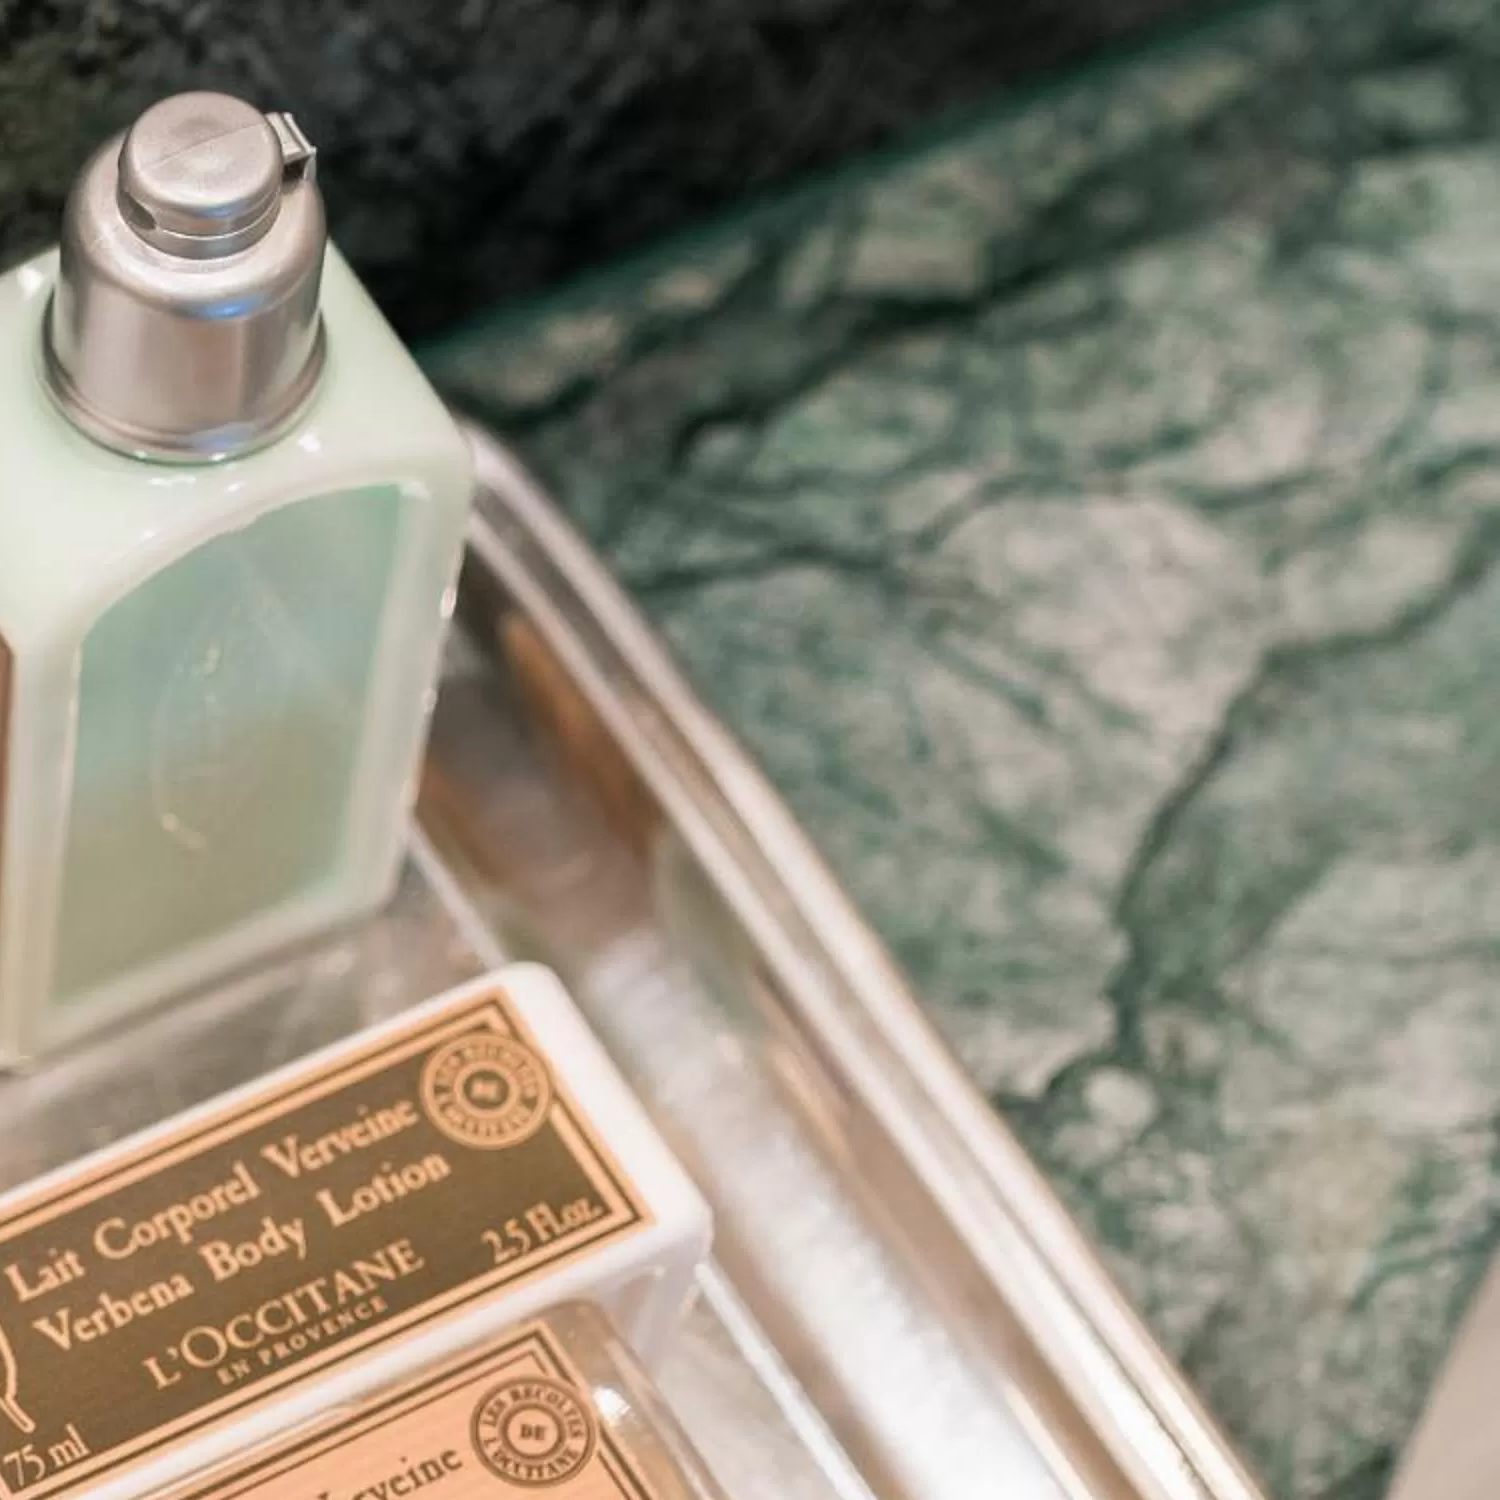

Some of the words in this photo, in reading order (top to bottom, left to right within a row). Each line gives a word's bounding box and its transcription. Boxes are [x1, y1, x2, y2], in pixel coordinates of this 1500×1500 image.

[3, 1249, 85, 1302] Lait
[94, 1160, 260, 1261] Corporel
[261, 1098, 418, 1179] Verveine
[32, 1274, 193, 1352] Verbena
[200, 1215, 308, 1282] Body
[317, 1154, 451, 1226] Lotion
[142, 1240, 425, 1389] L'OCCITANE
[218, 1357, 251, 1385] EN
[258, 1296, 388, 1367] PROVENCE
[3, 1443, 45, 1487] 75
[47, 1423, 91, 1468] ml
